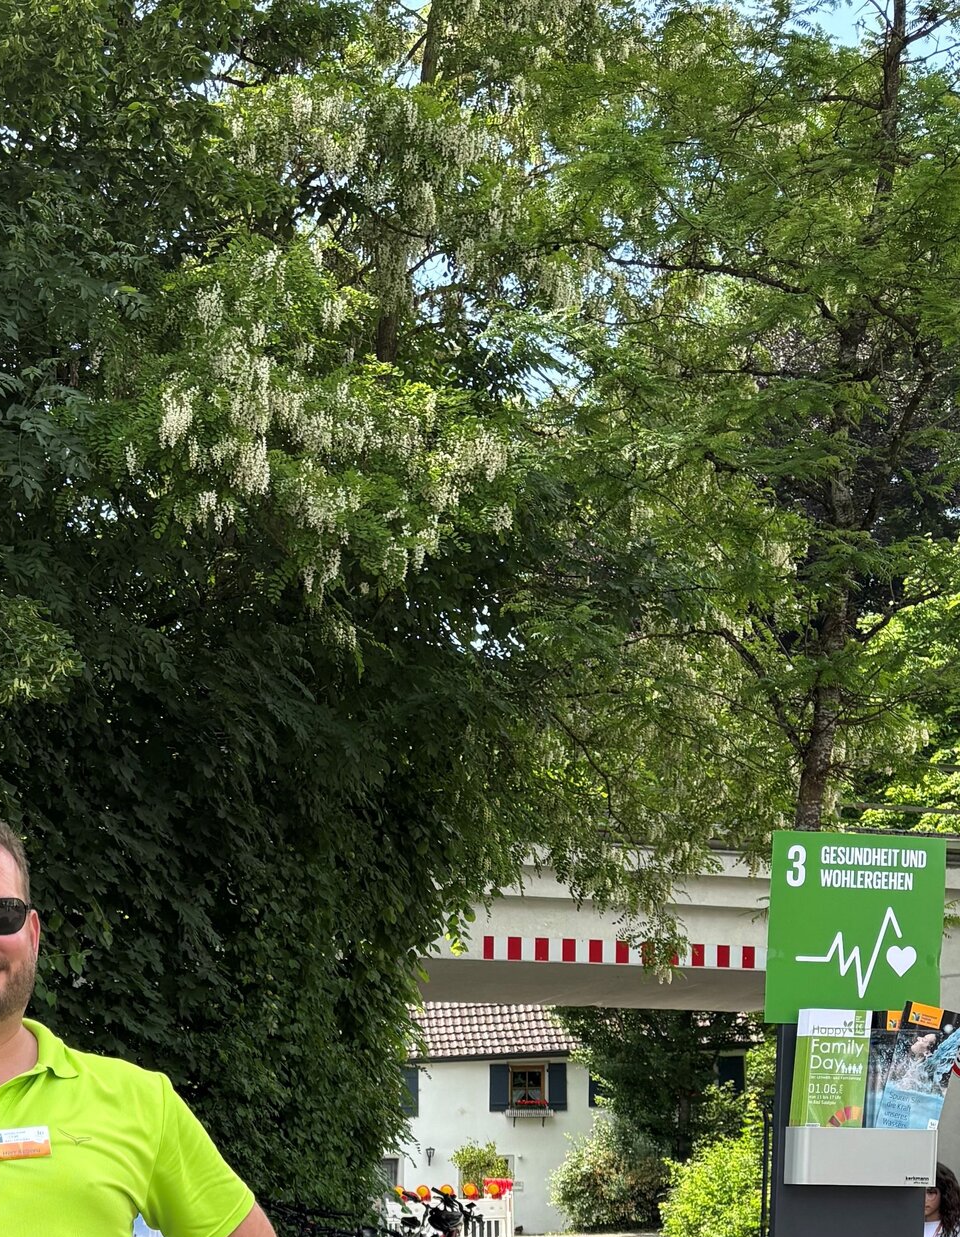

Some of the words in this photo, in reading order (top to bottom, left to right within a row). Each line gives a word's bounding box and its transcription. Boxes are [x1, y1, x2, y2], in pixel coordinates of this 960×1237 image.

[786, 845, 807, 887] 3
[821, 846, 900, 867] GESUNDHEIT
[901, 849, 927, 868] UND
[820, 869, 913, 890] WOHLERGEHEN
[812, 1025, 847, 1037] Happy
[811, 1039, 864, 1057] Family
[810, 1055, 843, 1073] Day
